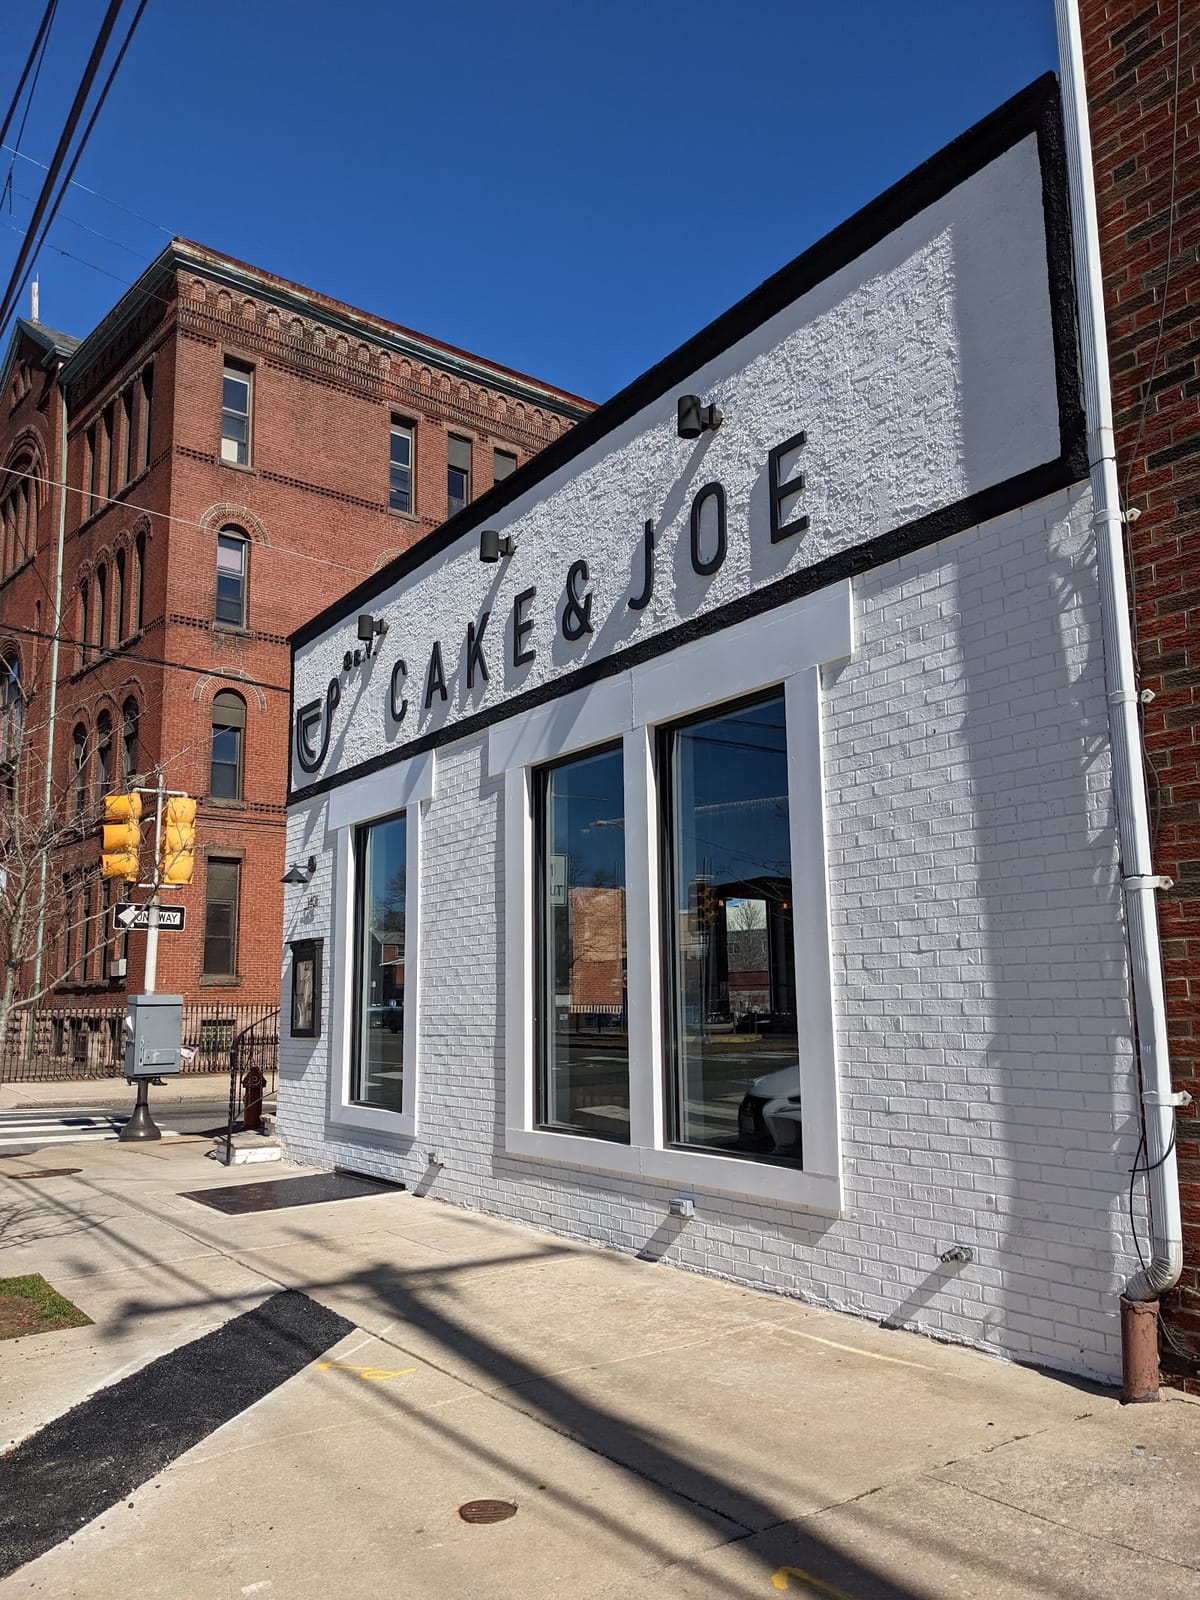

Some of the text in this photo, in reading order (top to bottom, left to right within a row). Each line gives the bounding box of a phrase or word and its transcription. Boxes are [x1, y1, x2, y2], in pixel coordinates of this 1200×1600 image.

[391, 431, 810, 722] CAKE & JOE
[159, 913, 178, 923] WAY
